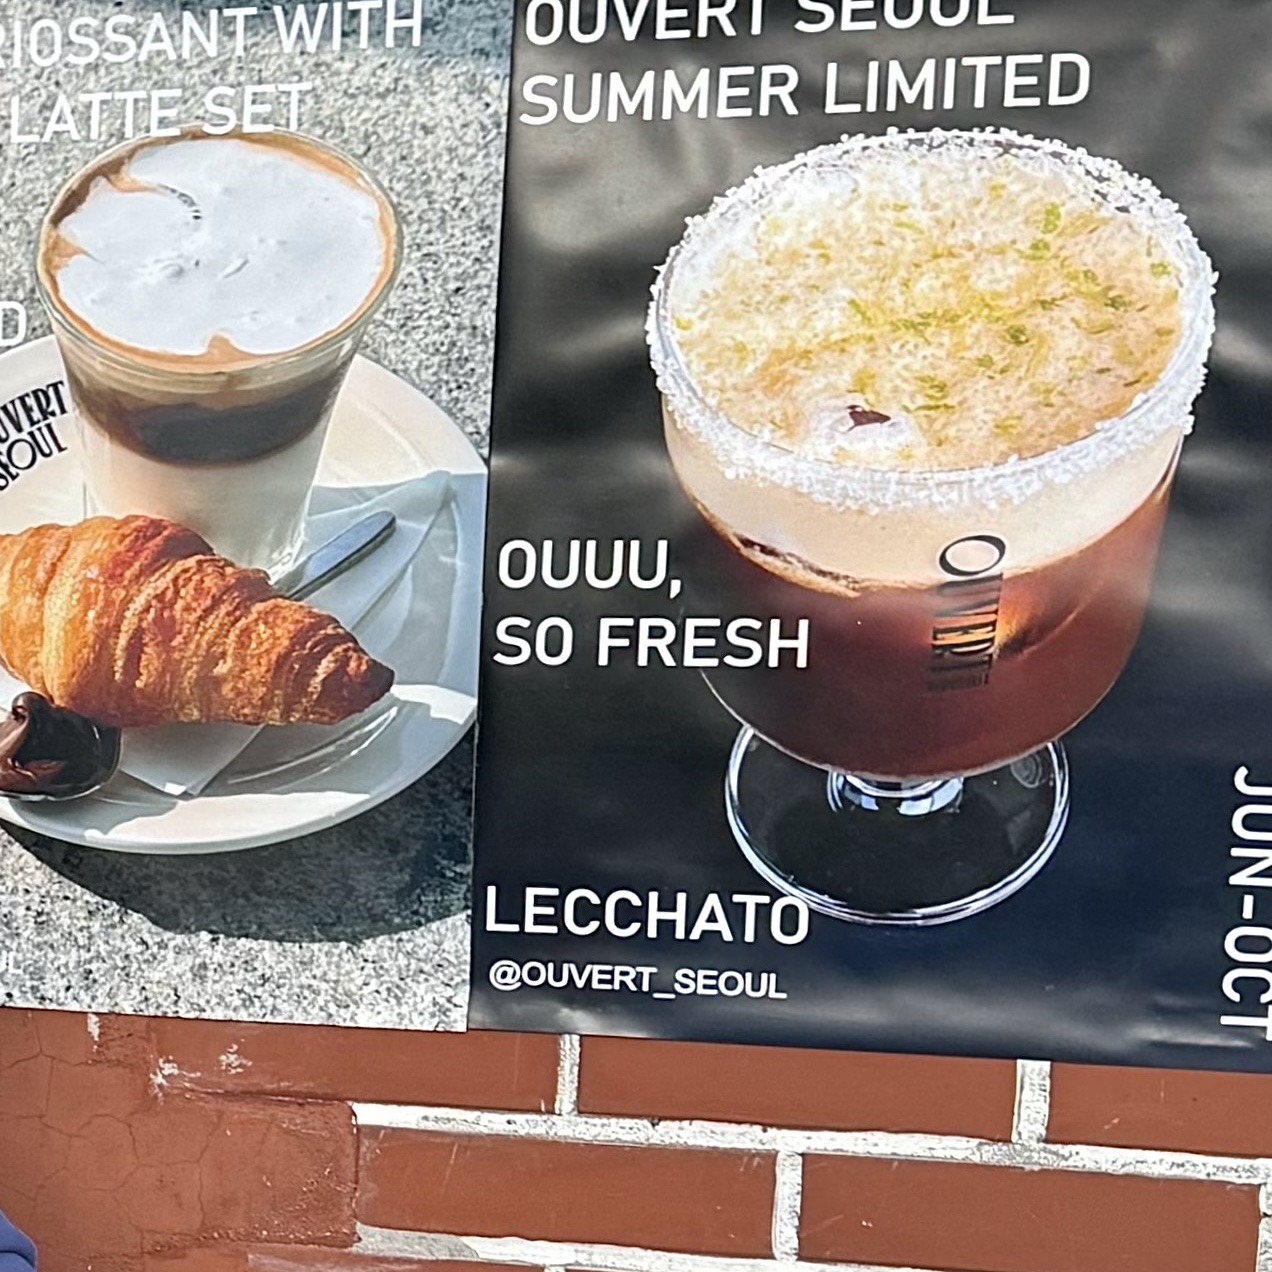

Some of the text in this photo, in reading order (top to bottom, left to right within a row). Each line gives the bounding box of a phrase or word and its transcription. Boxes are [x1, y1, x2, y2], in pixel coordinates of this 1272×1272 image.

[275, 0, 423, 54] WITH
[11, 88, 182, 143] LATTE
[201, 82, 312, 135] SET
[519, 54, 1089, 125] SUMMER LIMITED
[499, 540, 680, 598] OUUU,
[494, 617, 808, 667] SO FRESH
[928, 535, 1006, 691] OUVERT
[486, 885, 809, 945] LECCHATO
[1221, 767, 1272, 1040] JUN-OCT
[490, 961, 787, 998] @OUVERT_SEOUL
